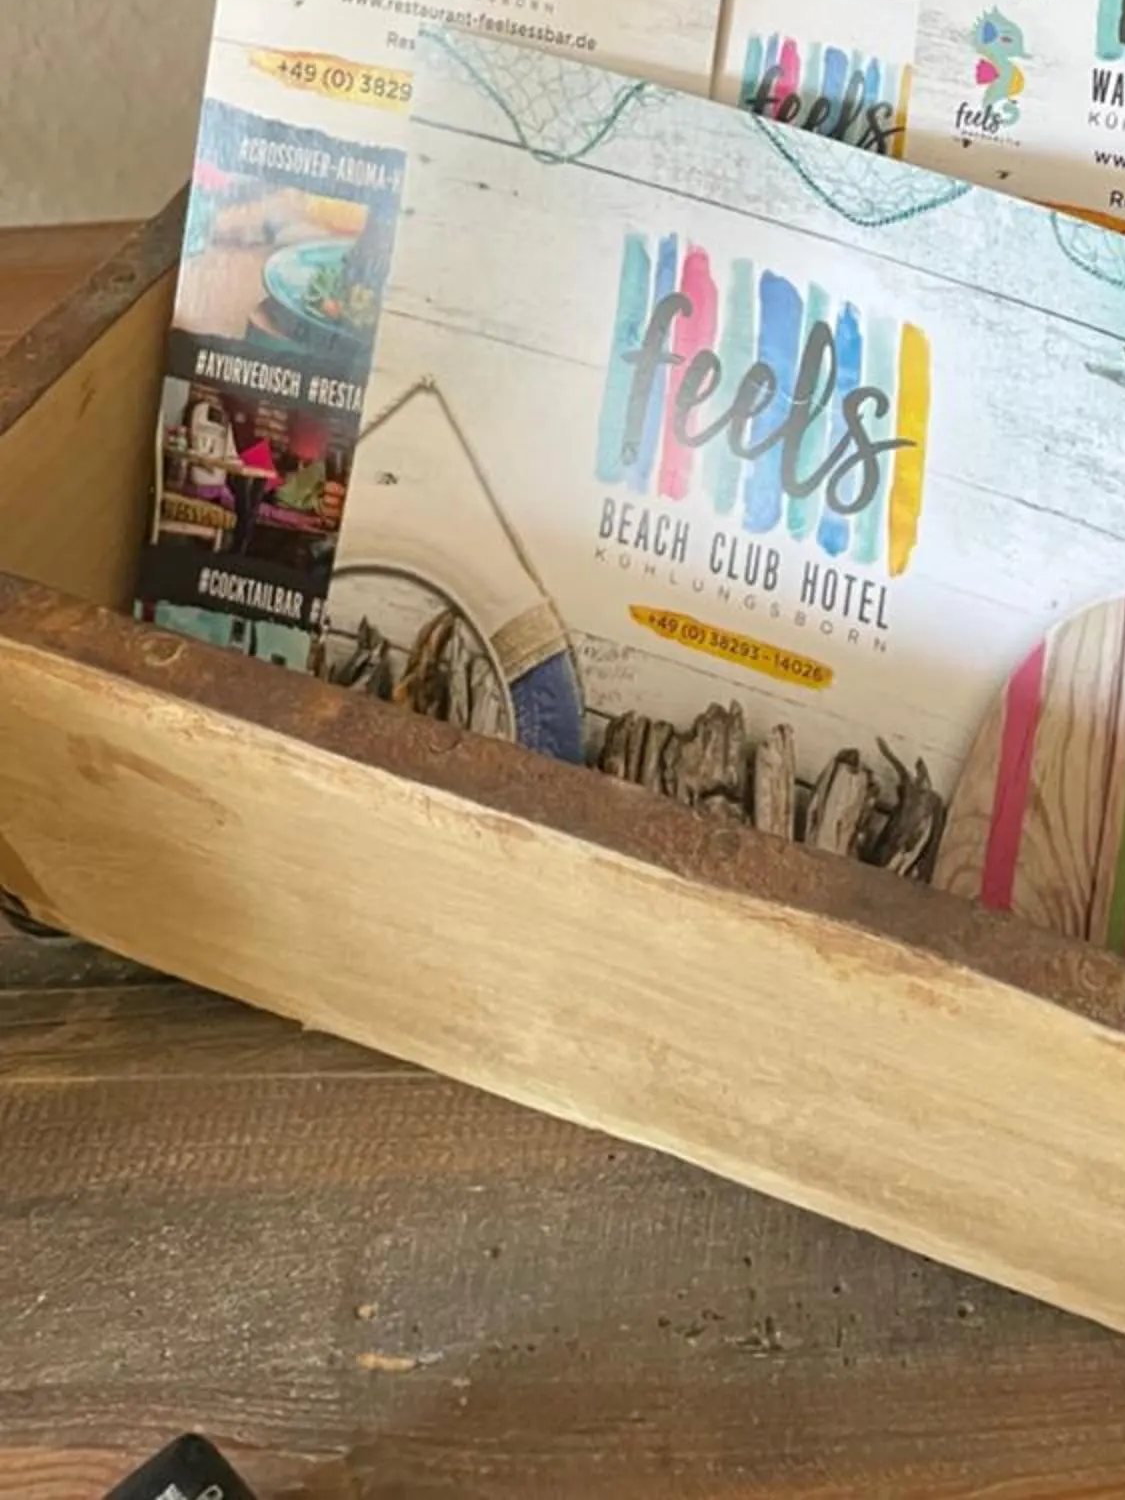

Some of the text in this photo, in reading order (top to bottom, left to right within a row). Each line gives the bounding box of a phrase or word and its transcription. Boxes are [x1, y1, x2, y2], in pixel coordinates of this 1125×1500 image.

[277, 60, 318, 83] +49
[320, 67, 355, 93] (0)
[955, 100, 1004, 134] feels
[195, 348, 303, 399] #AYURVEDISCH
[620, 291, 918, 515] feels
[598, 498, 889, 630] BEACH CLUB HOTEL
[198, 566, 305, 620] #COCKTAILBAR
[648, 613, 679, 634] +49
[681, 624, 707, 645] (0)
